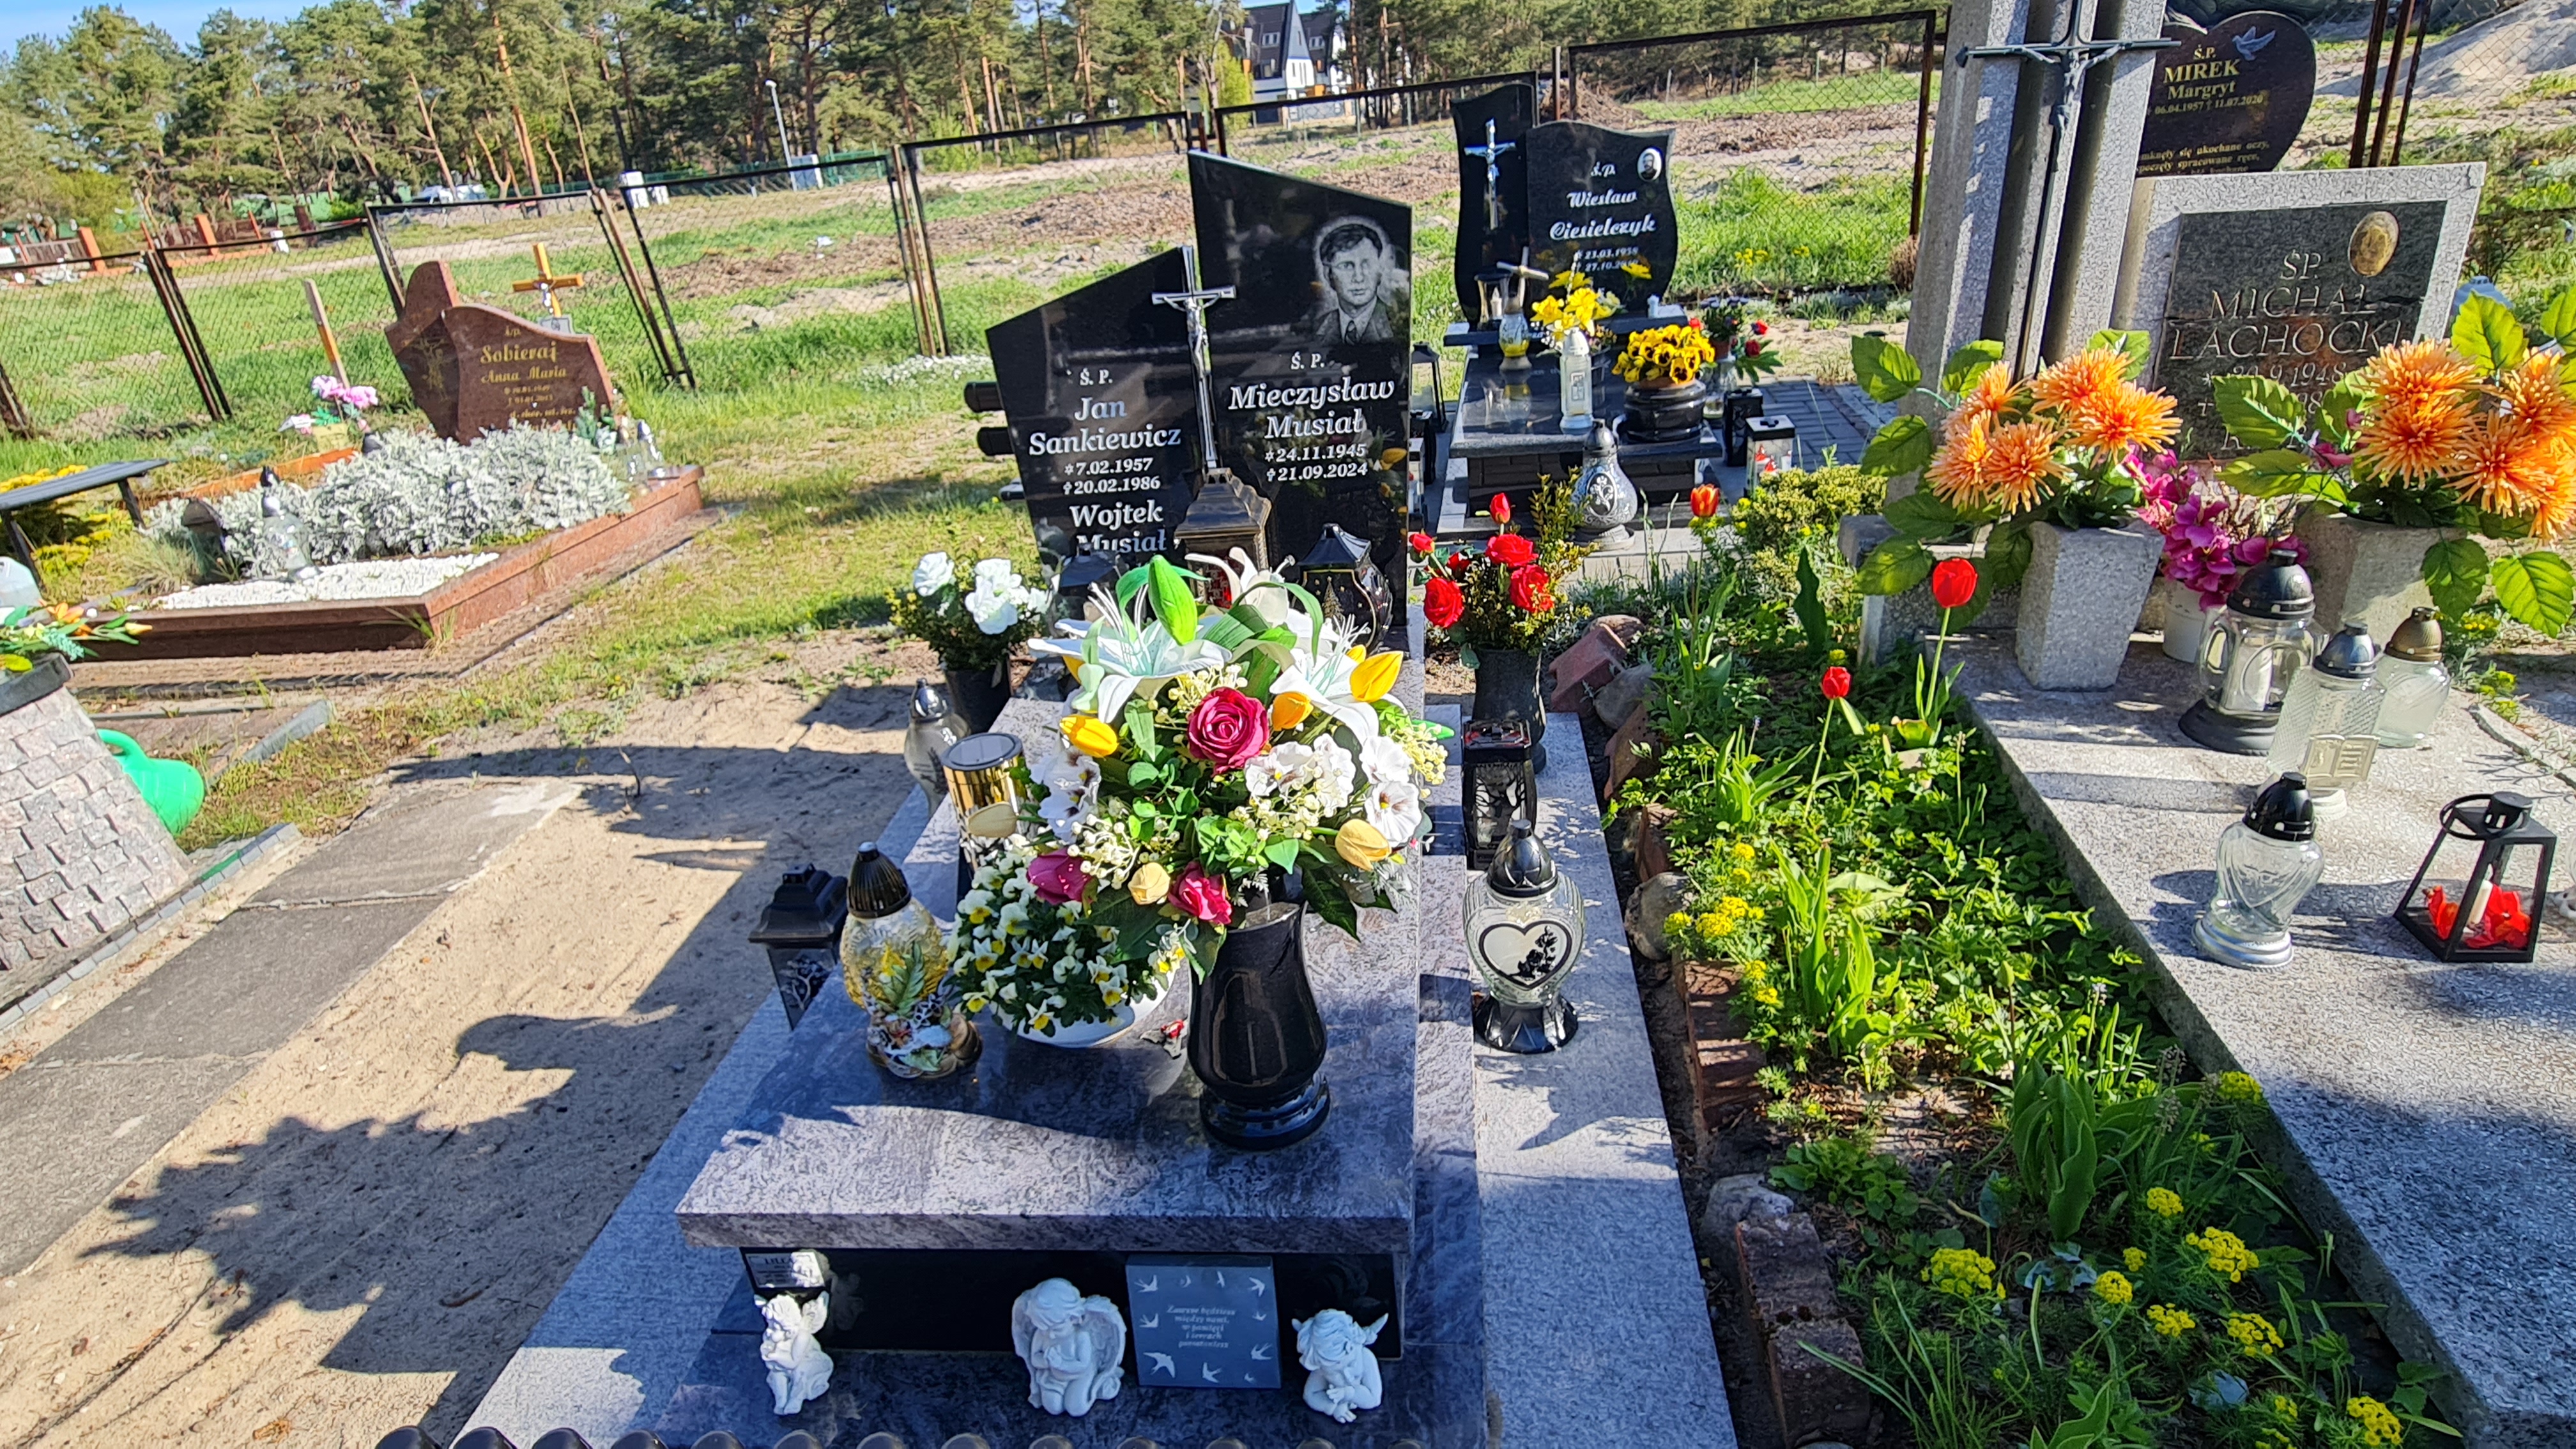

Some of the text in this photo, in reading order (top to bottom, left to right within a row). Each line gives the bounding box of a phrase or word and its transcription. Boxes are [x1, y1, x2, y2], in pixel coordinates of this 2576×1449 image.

[2163, 59, 2241, 84] MIREK
[2168, 80, 2236, 100] Margryt
[2154, 102, 2204, 115] 06.04.1957
[2196, 143, 2242, 155] ukochane
[1549, 213, 1657, 240] Ciesielczyk
[2208, 283, 2376, 319] MICHAŁ
[480, 341, 557, 364] Sobieraj
[480, 365, 567, 383] Anna Maria
[1228, 376, 1395, 410] Mieczysław
[1075, 397, 1128, 421] Jan
[1264, 408, 1365, 439] Musiał
[1029, 424, 1181, 455] Sankiewicz
[1276, 443, 1367, 462] 24.11.1945
[1075, 457, 1153, 476] 7.02.1957
[1278, 462, 1368, 481] 21.09.2024
[1074, 476, 1161, 494] 20.02.1986
[1069, 500, 1163, 531] Wojtek
